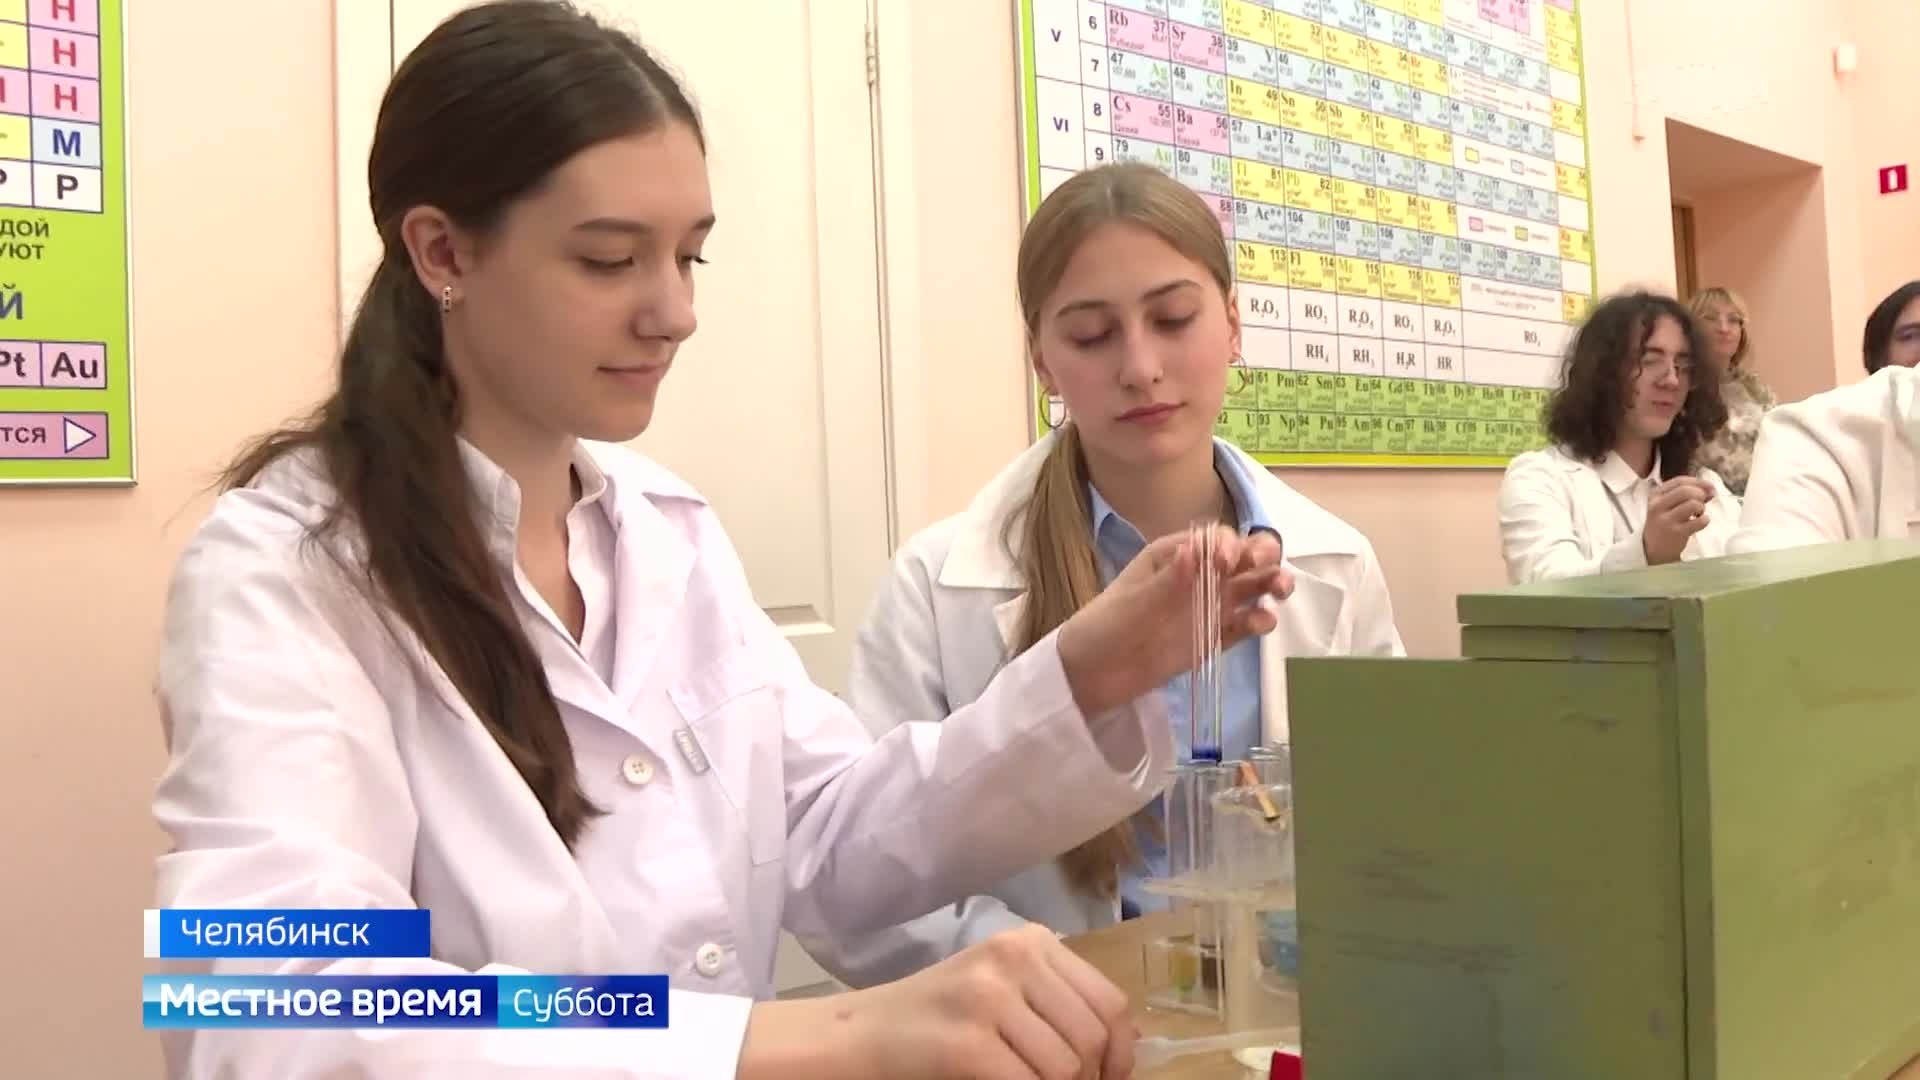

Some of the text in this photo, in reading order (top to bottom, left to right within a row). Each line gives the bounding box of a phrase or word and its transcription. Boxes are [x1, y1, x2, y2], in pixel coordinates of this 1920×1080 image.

[1110, 9, 1166, 32] Rb 37
[1261, 9, 1272, 22] 31
[1088, 15, 1097, 30] 6
[1051, 28, 1061, 42] V
[1172, 25, 1223, 48] Sr 38
[1227, 40, 1238, 52] 39
[1091, 58, 1099, 72] 7
[1110, 52, 1123, 65] 47
[1279, 53, 1289, 65] 40
[1174, 67, 1186, 80] 48
[1326, 65, 1336, 77] 41
[1230, 80, 1278, 101] In 49
[1372, 79, 1381, 90] 42
[1114, 96, 1171, 118] Cs 55
[1281, 92, 1326, 112] Sn 50
[1093, 102, 1102, 117] 8
[1053, 116, 1069, 132] VI
[1177, 108, 1228, 129] Ba 56
[1361, 112, 1370, 123] 51
[1232, 120, 1242, 131] 57
[1283, 131, 1294, 144] 72
[1115, 139, 1128, 152] 79
[1331, 141, 1341, 154] 73
[1095, 147, 1104, 161] 9
[1178, 150, 1190, 163] 80
[1375, 151, 1385, 164] 74
[1271, 168, 1282, 180] 81
[1320, 178, 1330, 190] 82
[1365, 187, 1375, 199] 83
[1236, 202, 1247, 214] 89
[1287, 211, 1304, 224] 104
[1336, 219, 1351, 232] 105
[1380, 227, 1394, 239] 106
[1239, 243, 1286, 262] Nh 113
[1319, 256, 1335, 268] 114
[1365, 263, 1379, 275] 115
[1408, 270, 1421, 280] 116
[51, 351, 98, 378] Au
[1437, 356, 1452, 370] HR
[1257, 372, 1295, 388] 61 Pm
[1316, 376, 1333, 390] Sm
[1280, 414, 1296, 432] Np
